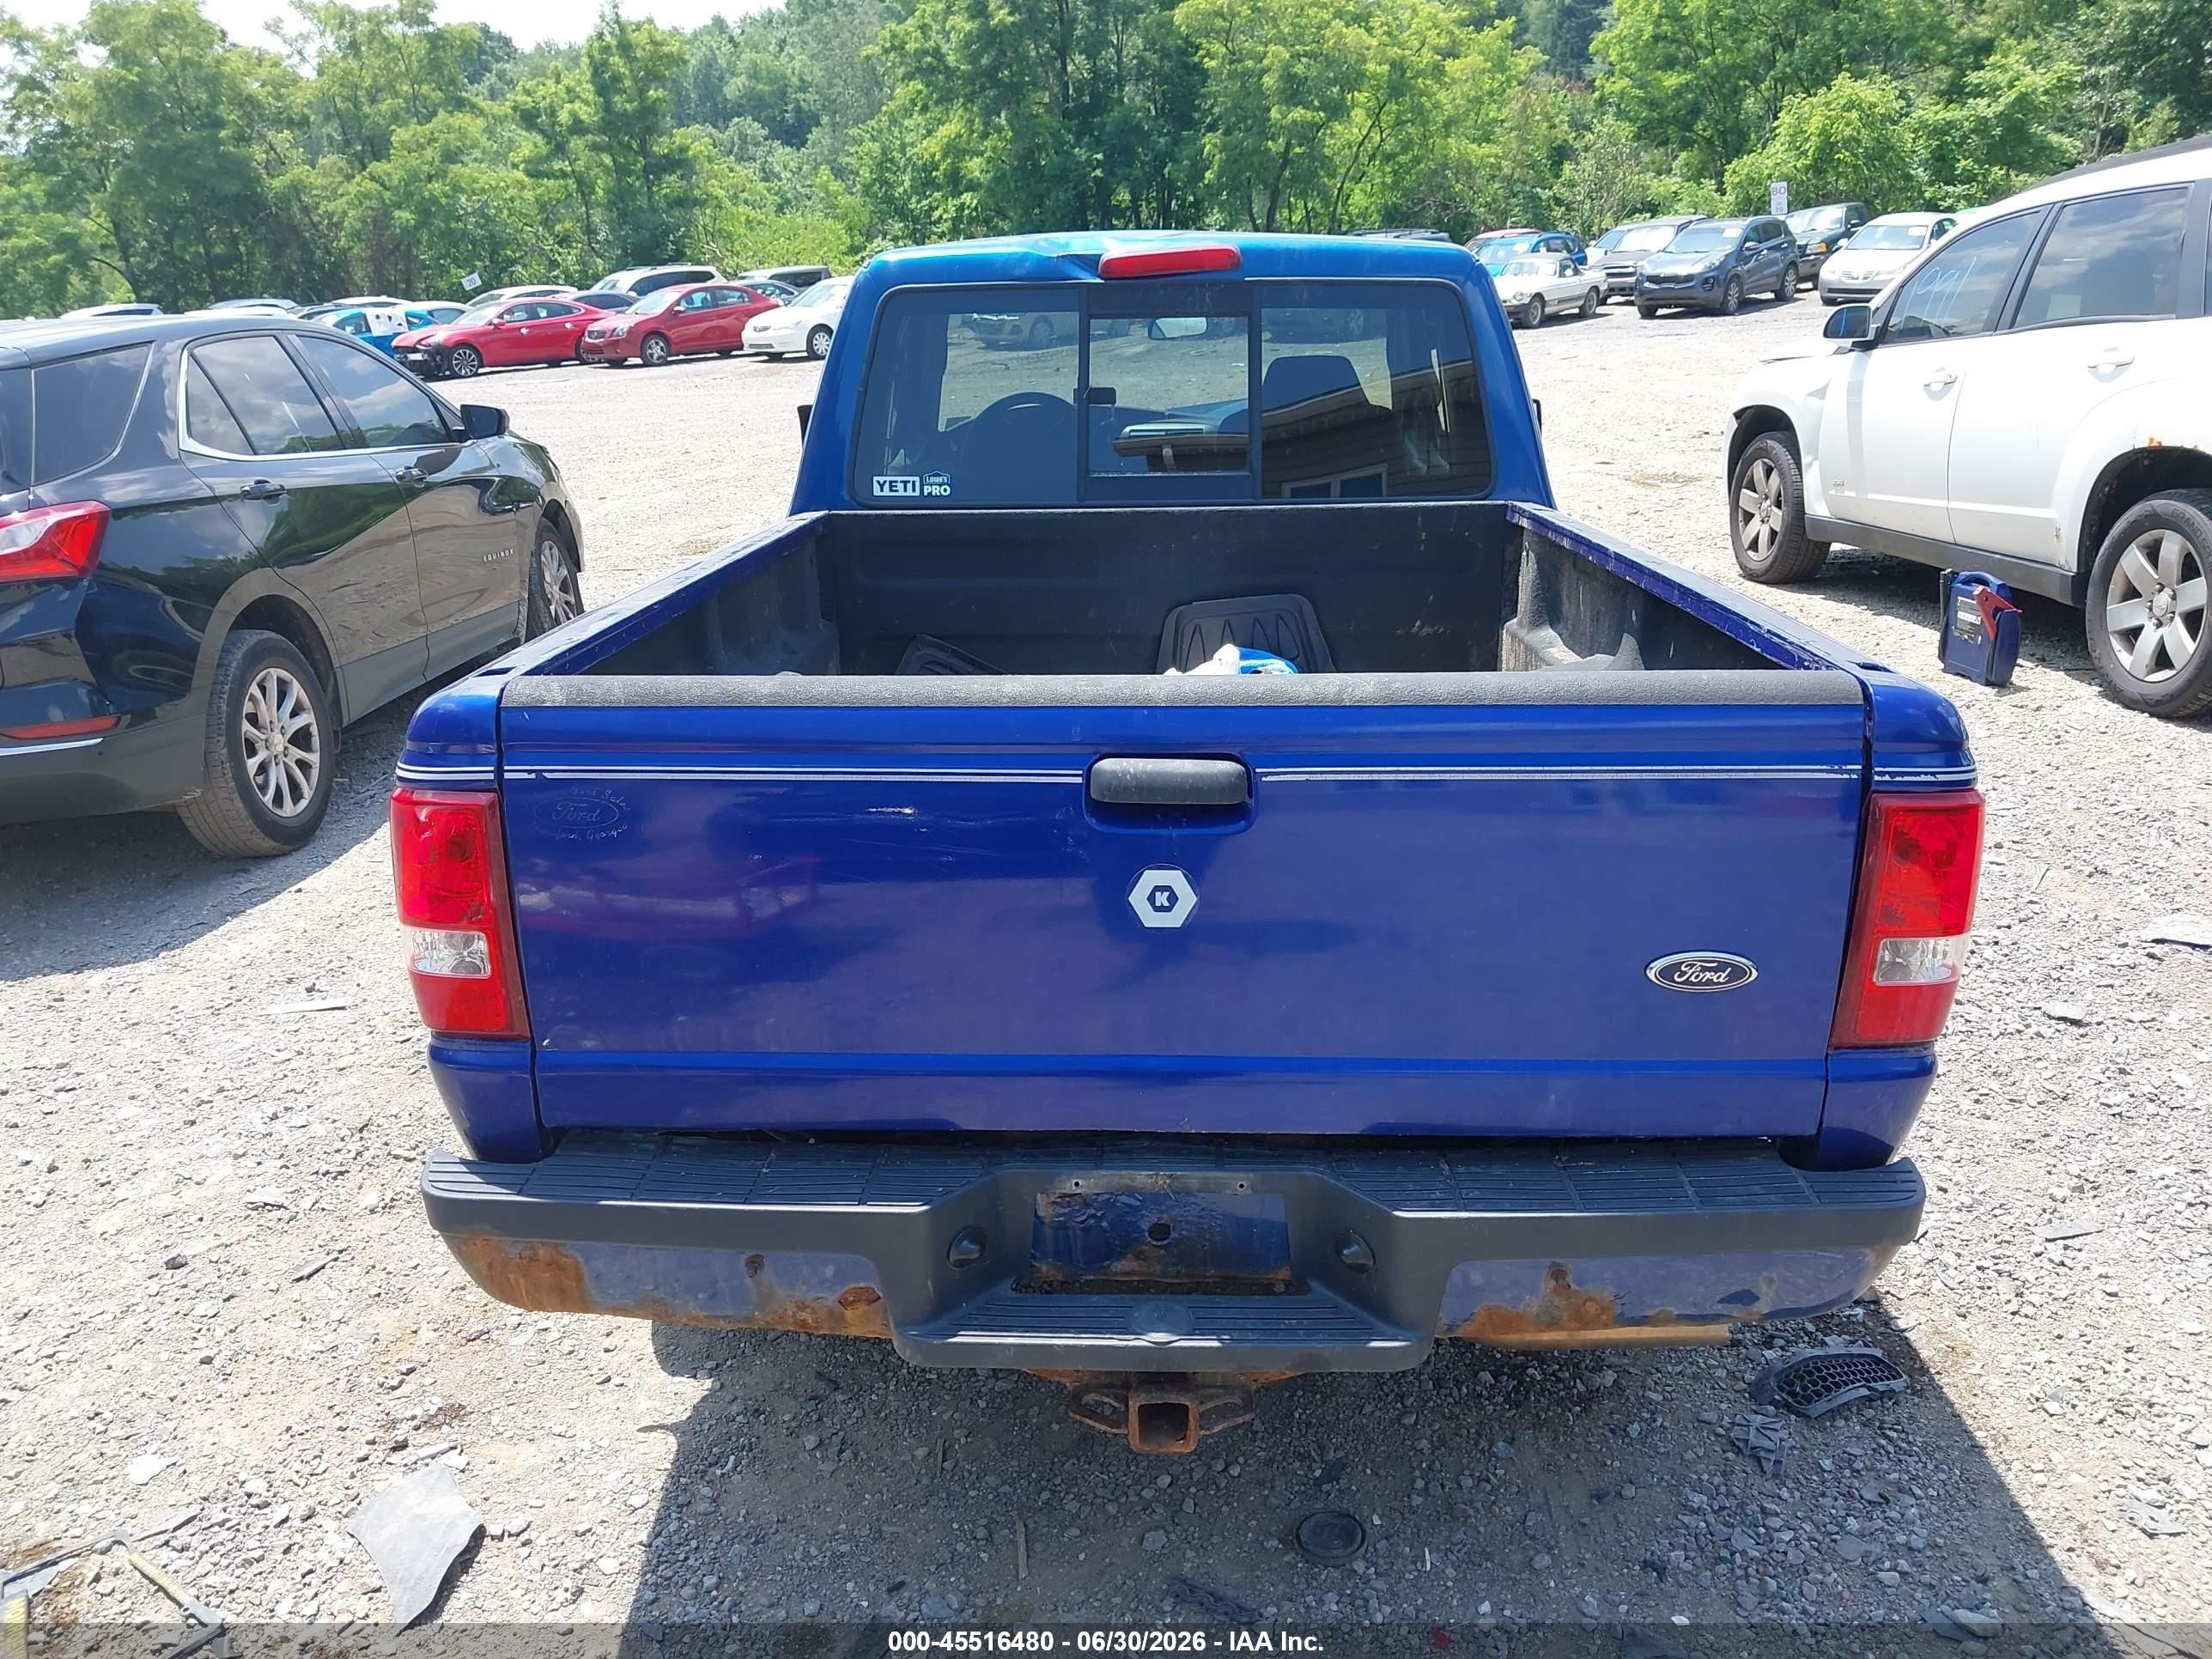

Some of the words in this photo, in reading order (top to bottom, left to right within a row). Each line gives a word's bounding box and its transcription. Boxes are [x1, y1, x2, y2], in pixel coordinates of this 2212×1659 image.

[875, 480, 919, 493] YETI
[923, 485, 951, 496] PRO
[483, 549, 514, 562] EQUINOX
[1155, 891, 1170, 907] K
[1674, 961, 1732, 983] Ford
